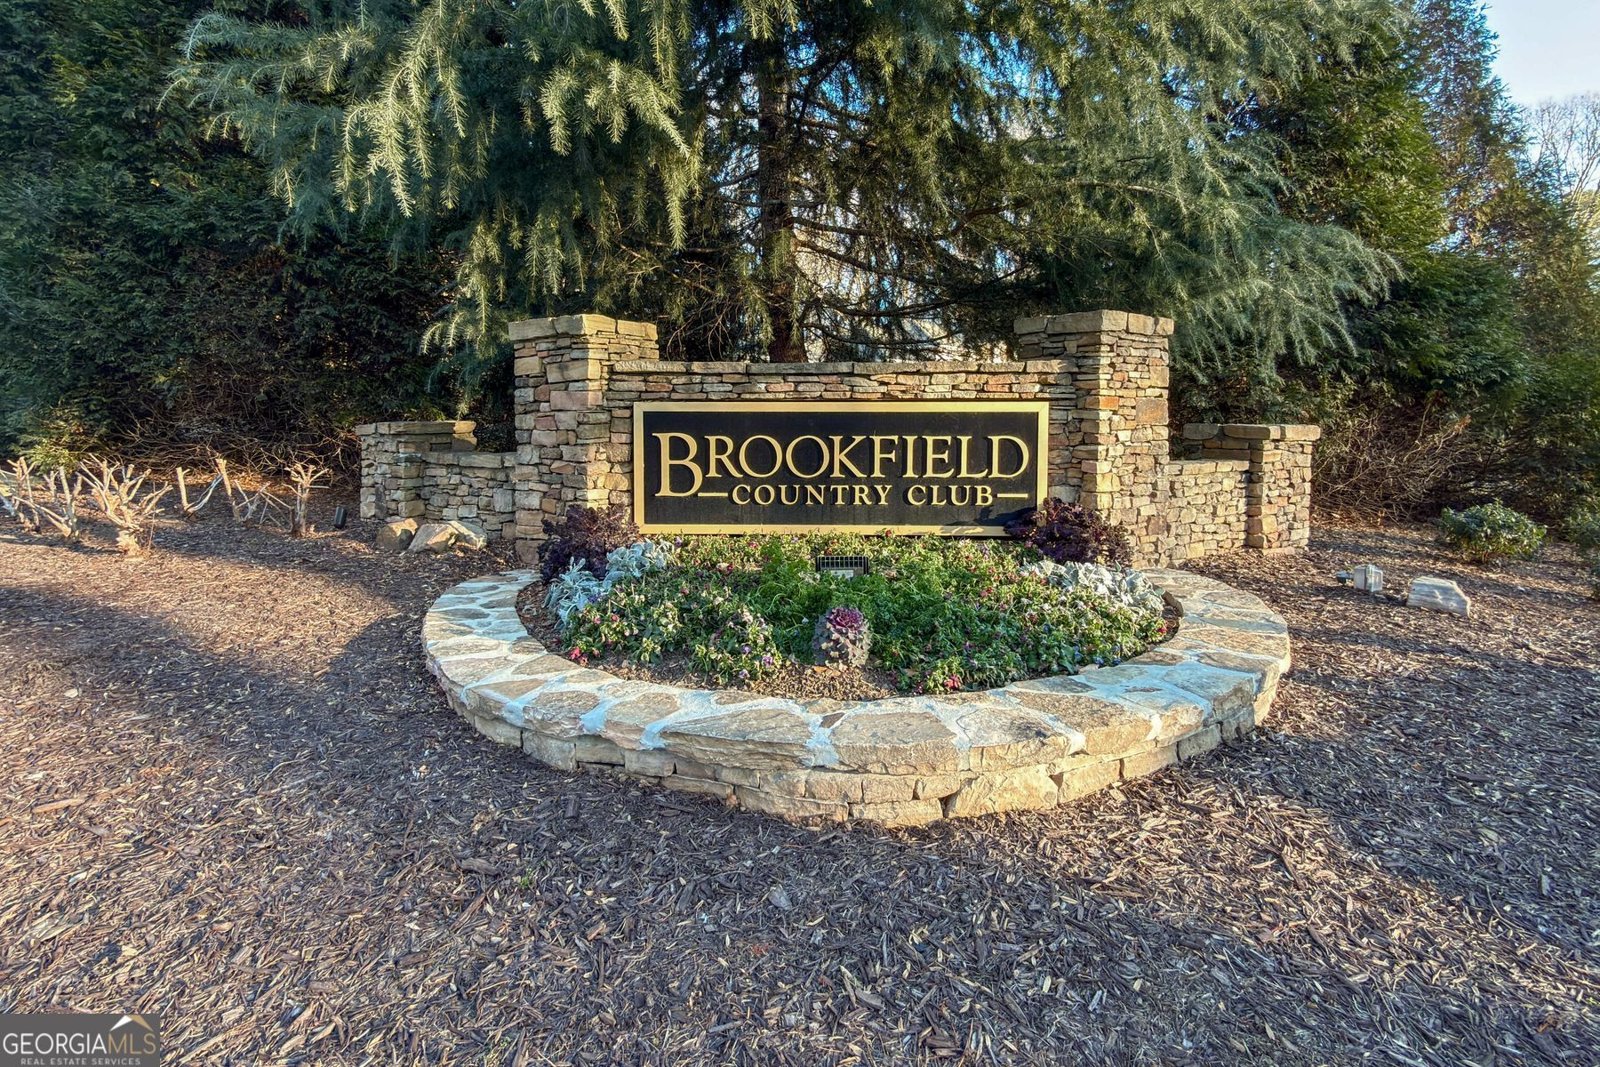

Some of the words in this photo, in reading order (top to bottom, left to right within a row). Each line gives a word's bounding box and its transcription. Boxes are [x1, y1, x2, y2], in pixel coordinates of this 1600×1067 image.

[651, 432, 1030, 498] BROOKFIELD
[732, 483, 893, 507] COUNTRY
[907, 483, 994, 508] CLUB
